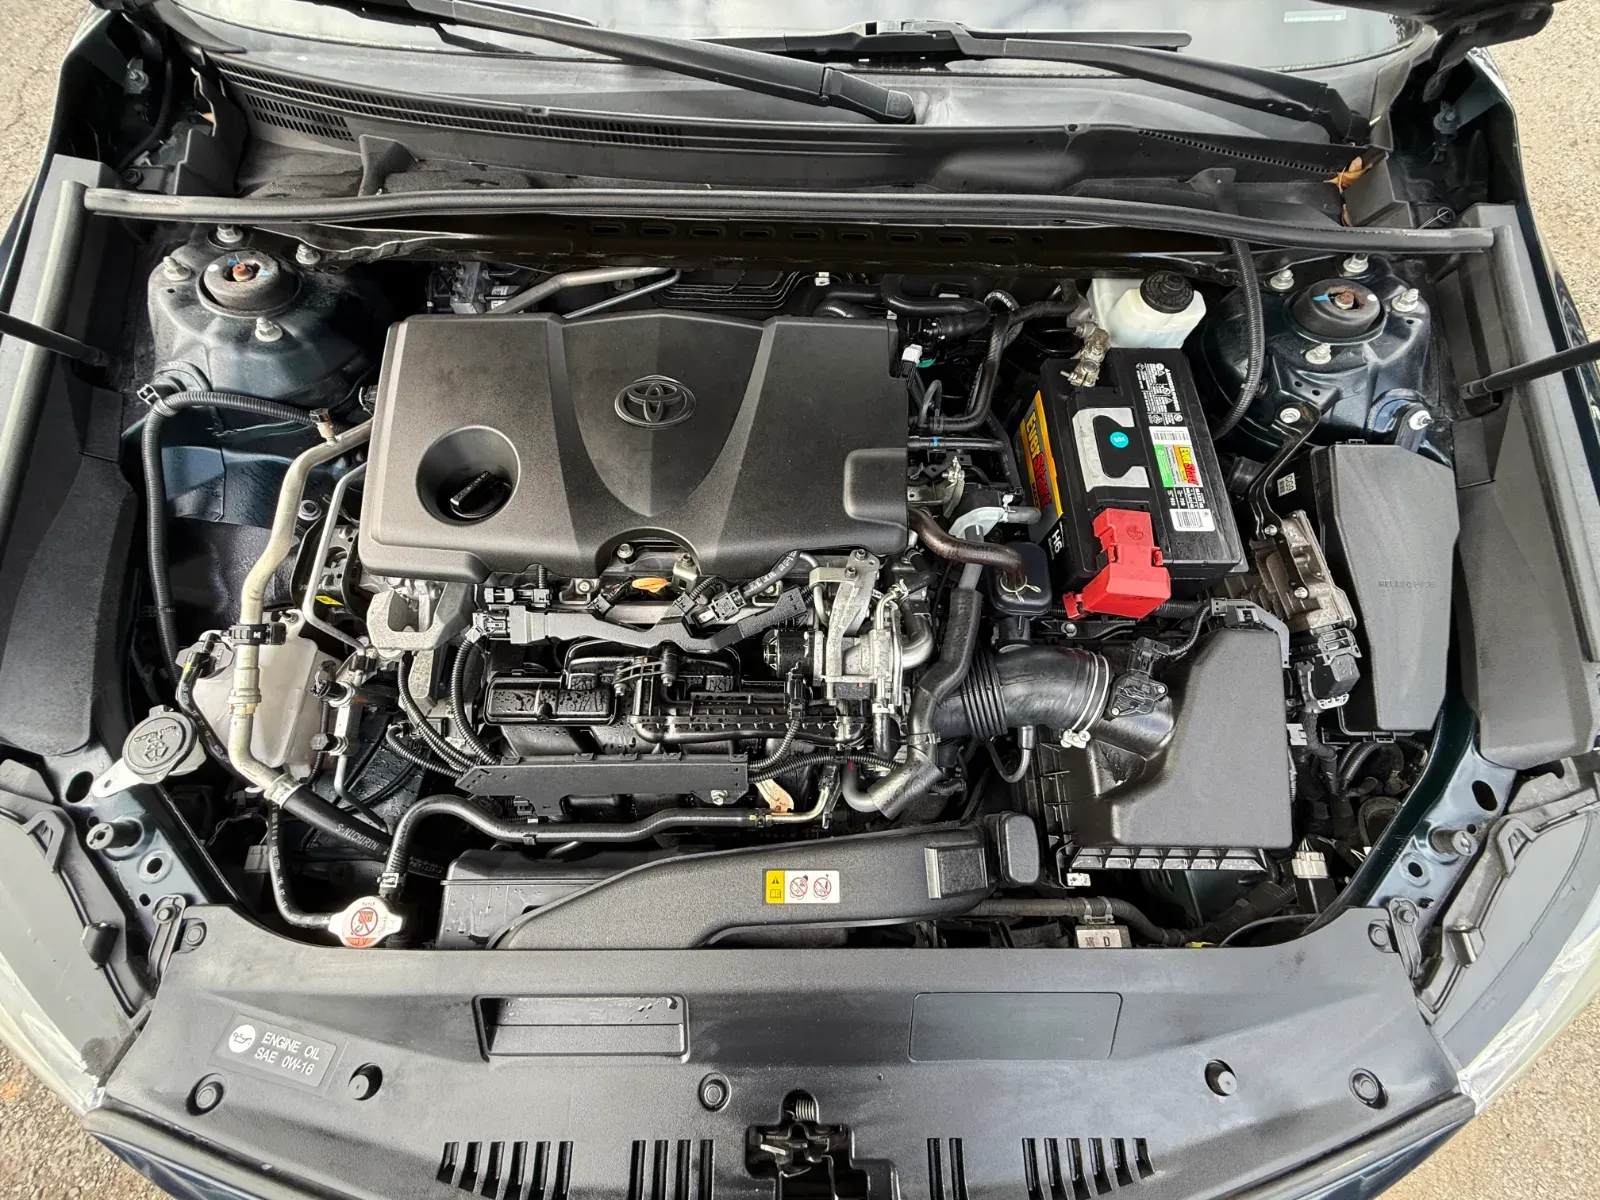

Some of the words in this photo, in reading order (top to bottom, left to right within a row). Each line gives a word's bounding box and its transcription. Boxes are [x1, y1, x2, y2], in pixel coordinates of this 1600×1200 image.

[1025, 410, 1052, 507] EverStart
[1179, 446, 1199, 486] EverStart
[1051, 528, 1063, 554] H6
[1102, 935, 1111, 947] D
[254, 1046, 279, 1064] SAE
[281, 1055, 316, 1076] 0W-16
[261, 1031, 302, 1054] ENGINE
[304, 1045, 321, 1061] OIL
